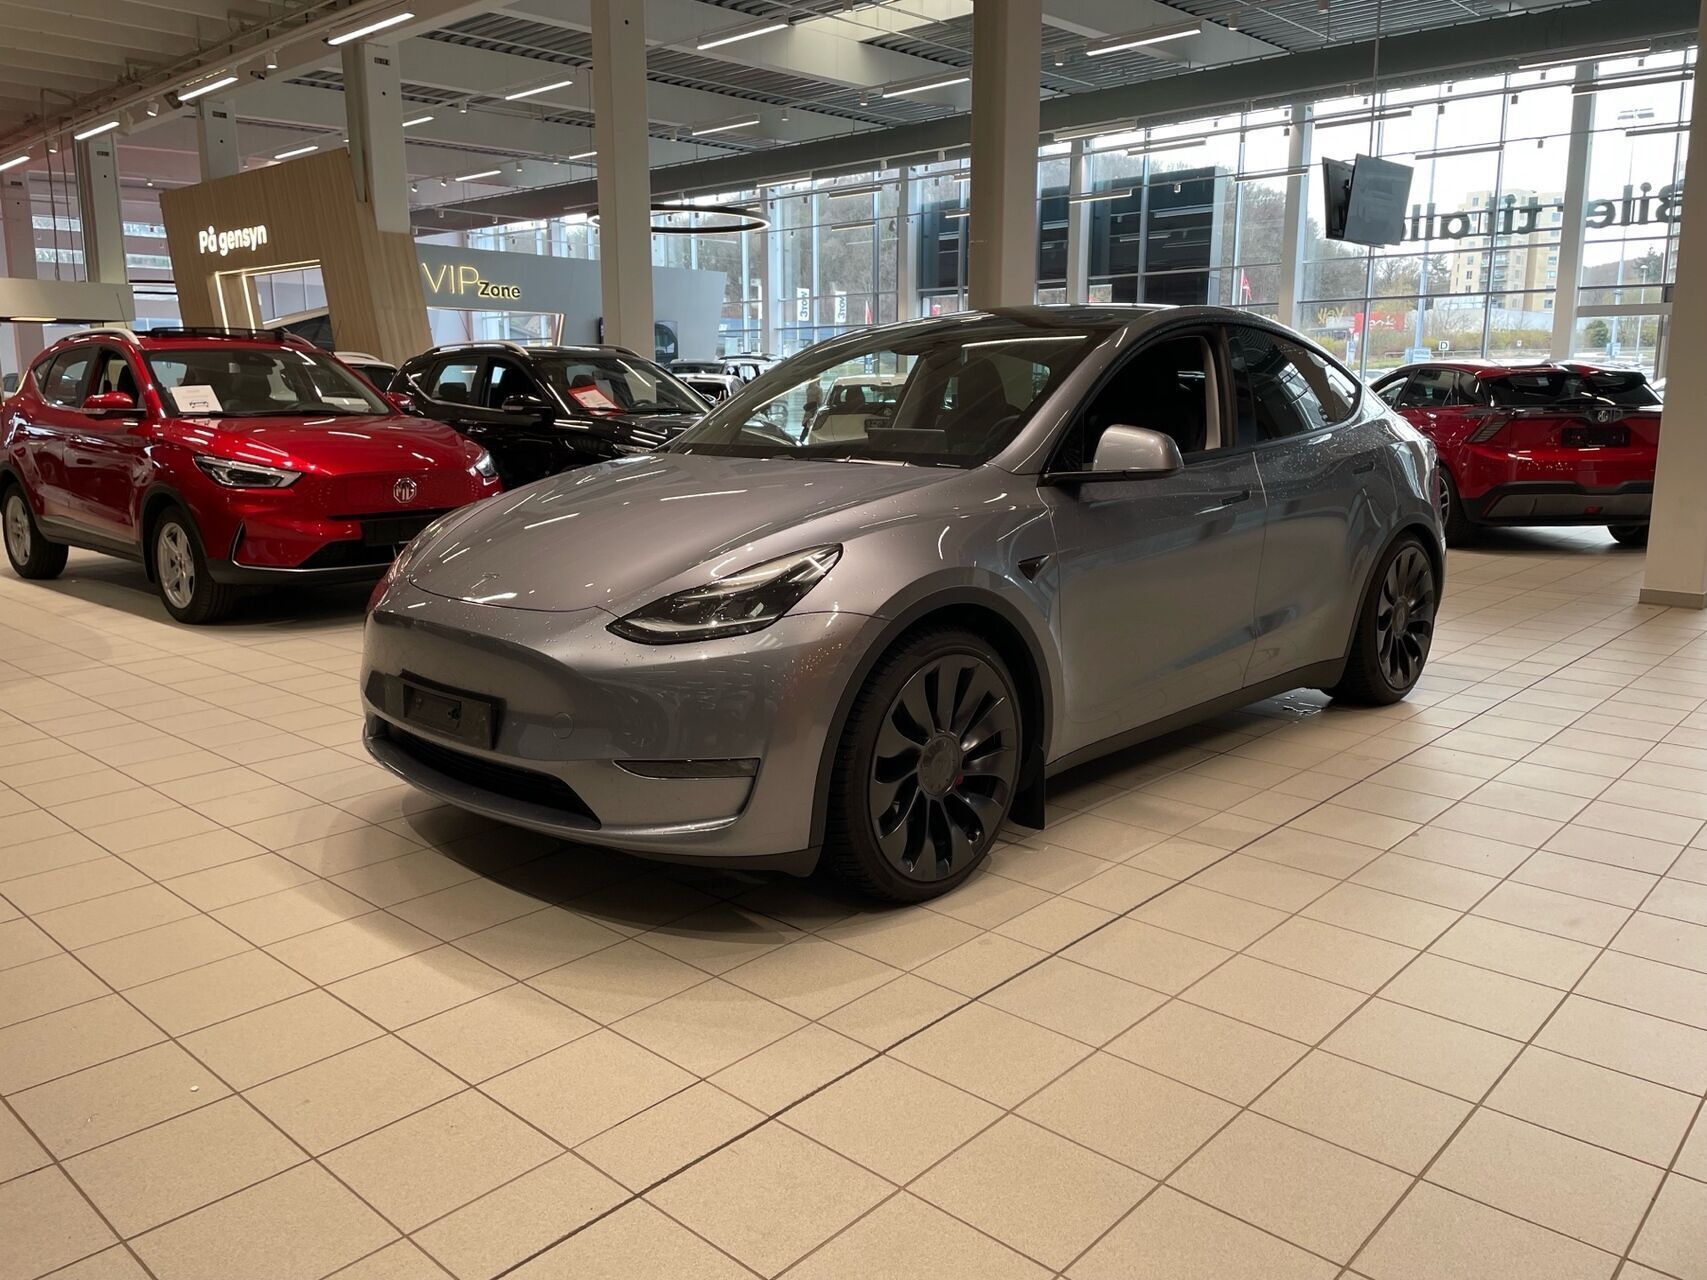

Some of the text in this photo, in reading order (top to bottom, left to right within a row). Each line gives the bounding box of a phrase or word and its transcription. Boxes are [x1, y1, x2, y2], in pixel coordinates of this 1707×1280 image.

[198, 224, 268, 257] På gensyn
[422, 262, 522, 300] VIP Zone
[394, 480, 416, 503] MG
